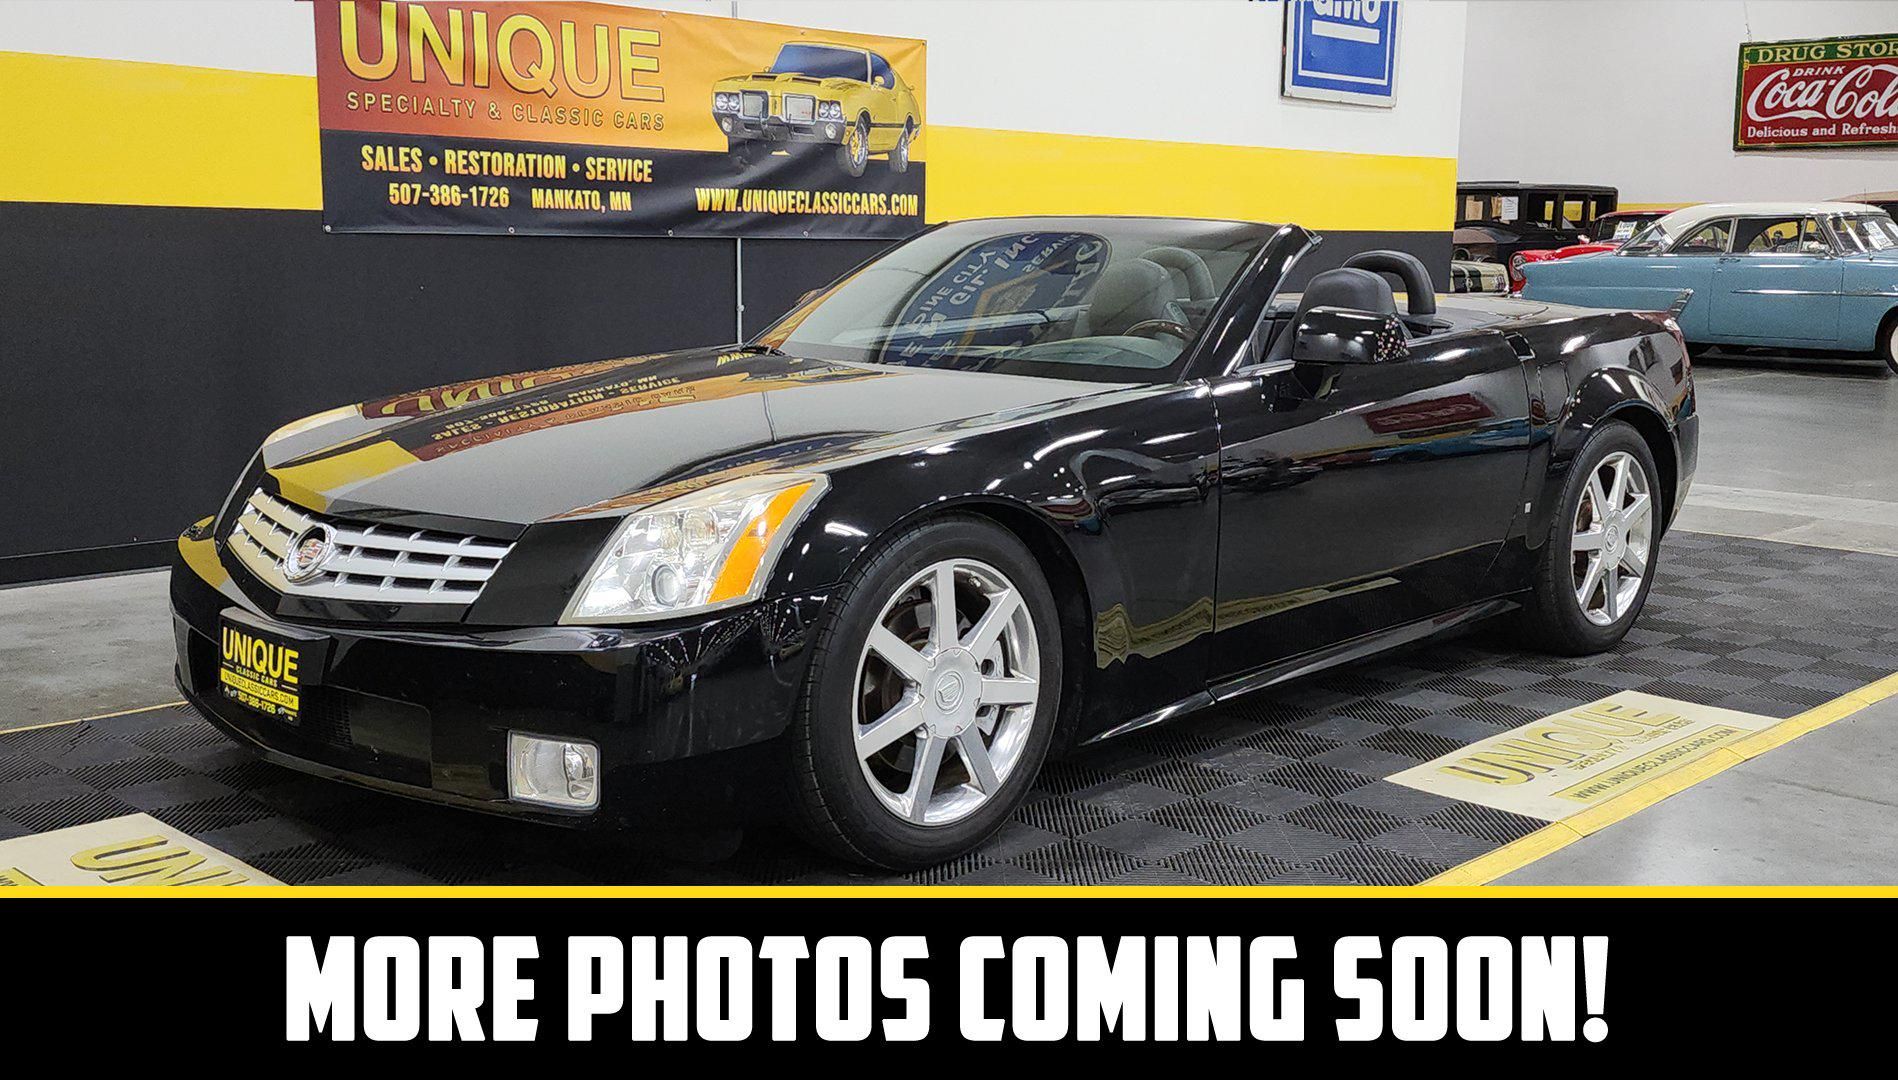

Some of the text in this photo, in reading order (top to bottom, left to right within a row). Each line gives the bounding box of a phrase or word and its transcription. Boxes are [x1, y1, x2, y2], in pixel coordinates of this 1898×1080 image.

[338, 0, 665, 102] UNIQUE
[1757, 45, 1826, 63] DRUG
[1792, 65, 1847, 78] DRINK
[346, 91, 665, 131] SPECIALTY & CLASSIC CARS
[1747, 122, 1898, 138] Delicious and Refresh
[361, 144, 654, 183] SALES RESTORATION SERVICE
[388, 182, 633, 214] 507-386-1726 MANKATO, MN
[694, 186, 919, 217] WWW.UNIQUECLASSICCARS.COM
[222, 626, 299, 684] UNIQUE
[1438, 702, 1680, 786] UNIQUE
